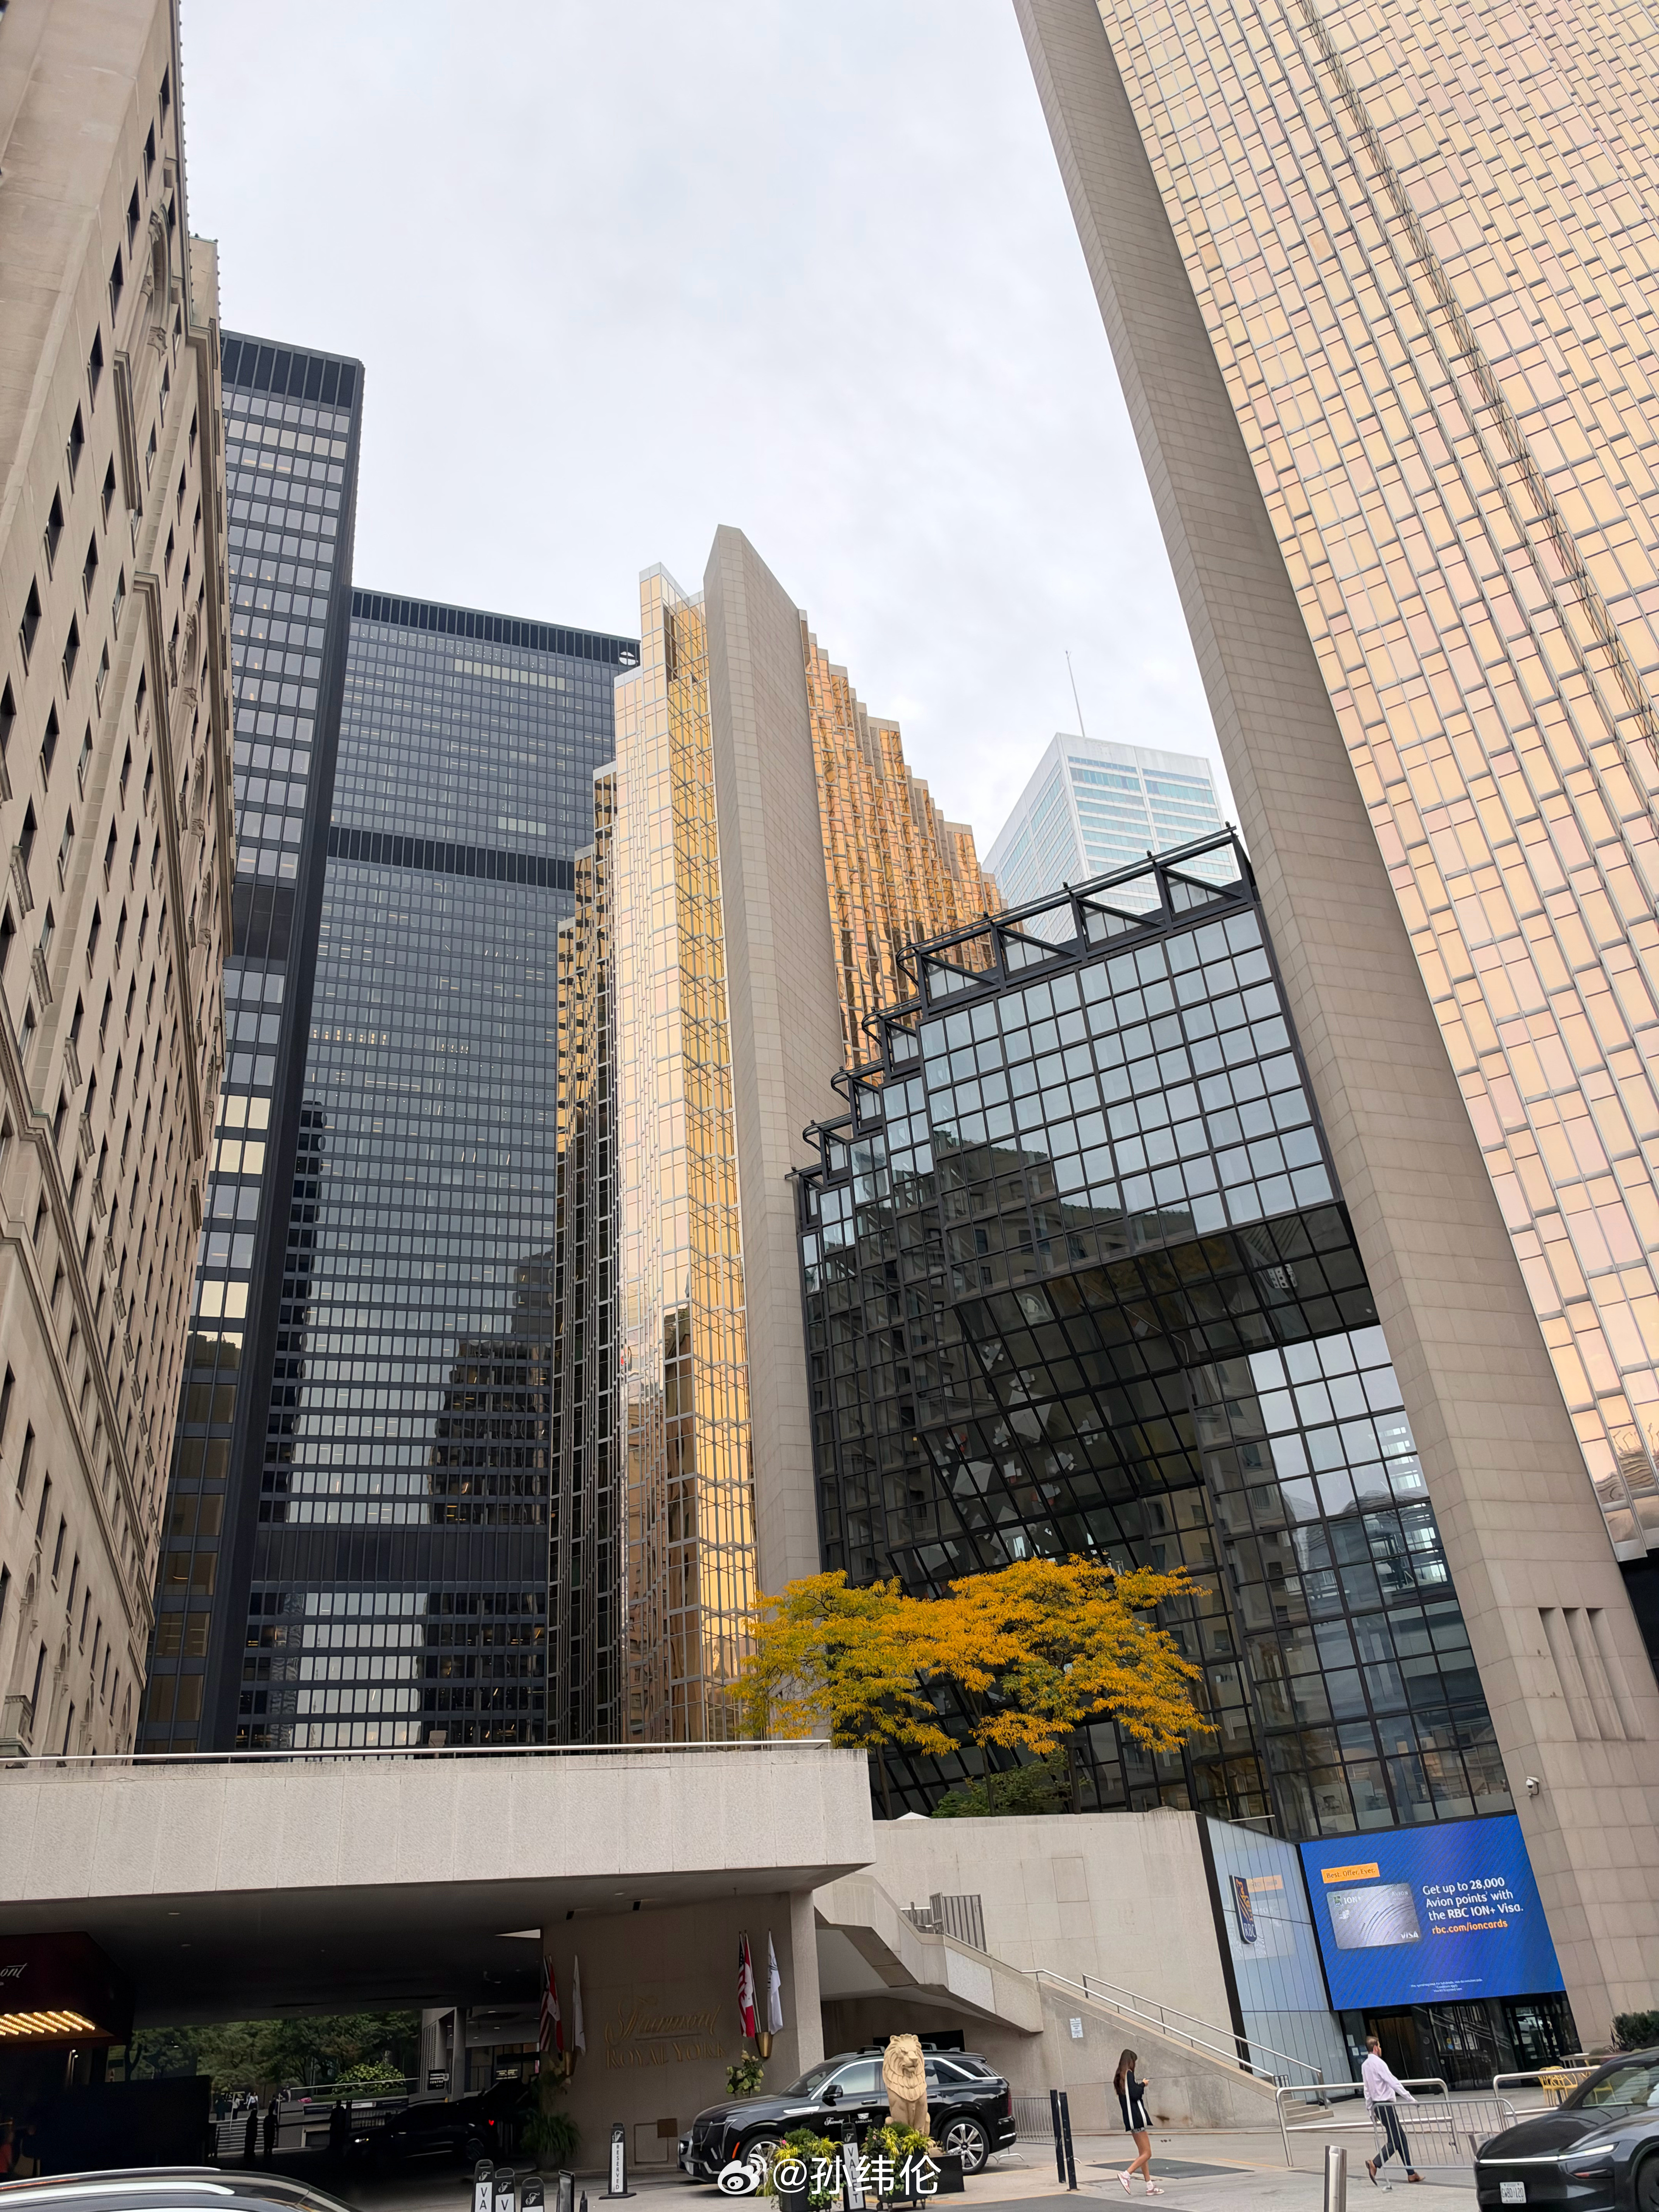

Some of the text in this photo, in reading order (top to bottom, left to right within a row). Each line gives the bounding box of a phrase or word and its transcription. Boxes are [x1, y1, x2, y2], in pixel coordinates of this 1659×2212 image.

[1422, 1877, 1504, 1895] Get up to 28,000
[1426, 1897, 1453, 1908] Avion
[1490, 1889, 1513, 1901] with
[1428, 1903, 1523, 1921] the RBC ION+ Visa.
[1243, 1922, 1256, 1937] RBC
[1400, 1930, 1419, 1939] VISA
[1432, 1918, 1508, 1934] rbc.com/ioncards
